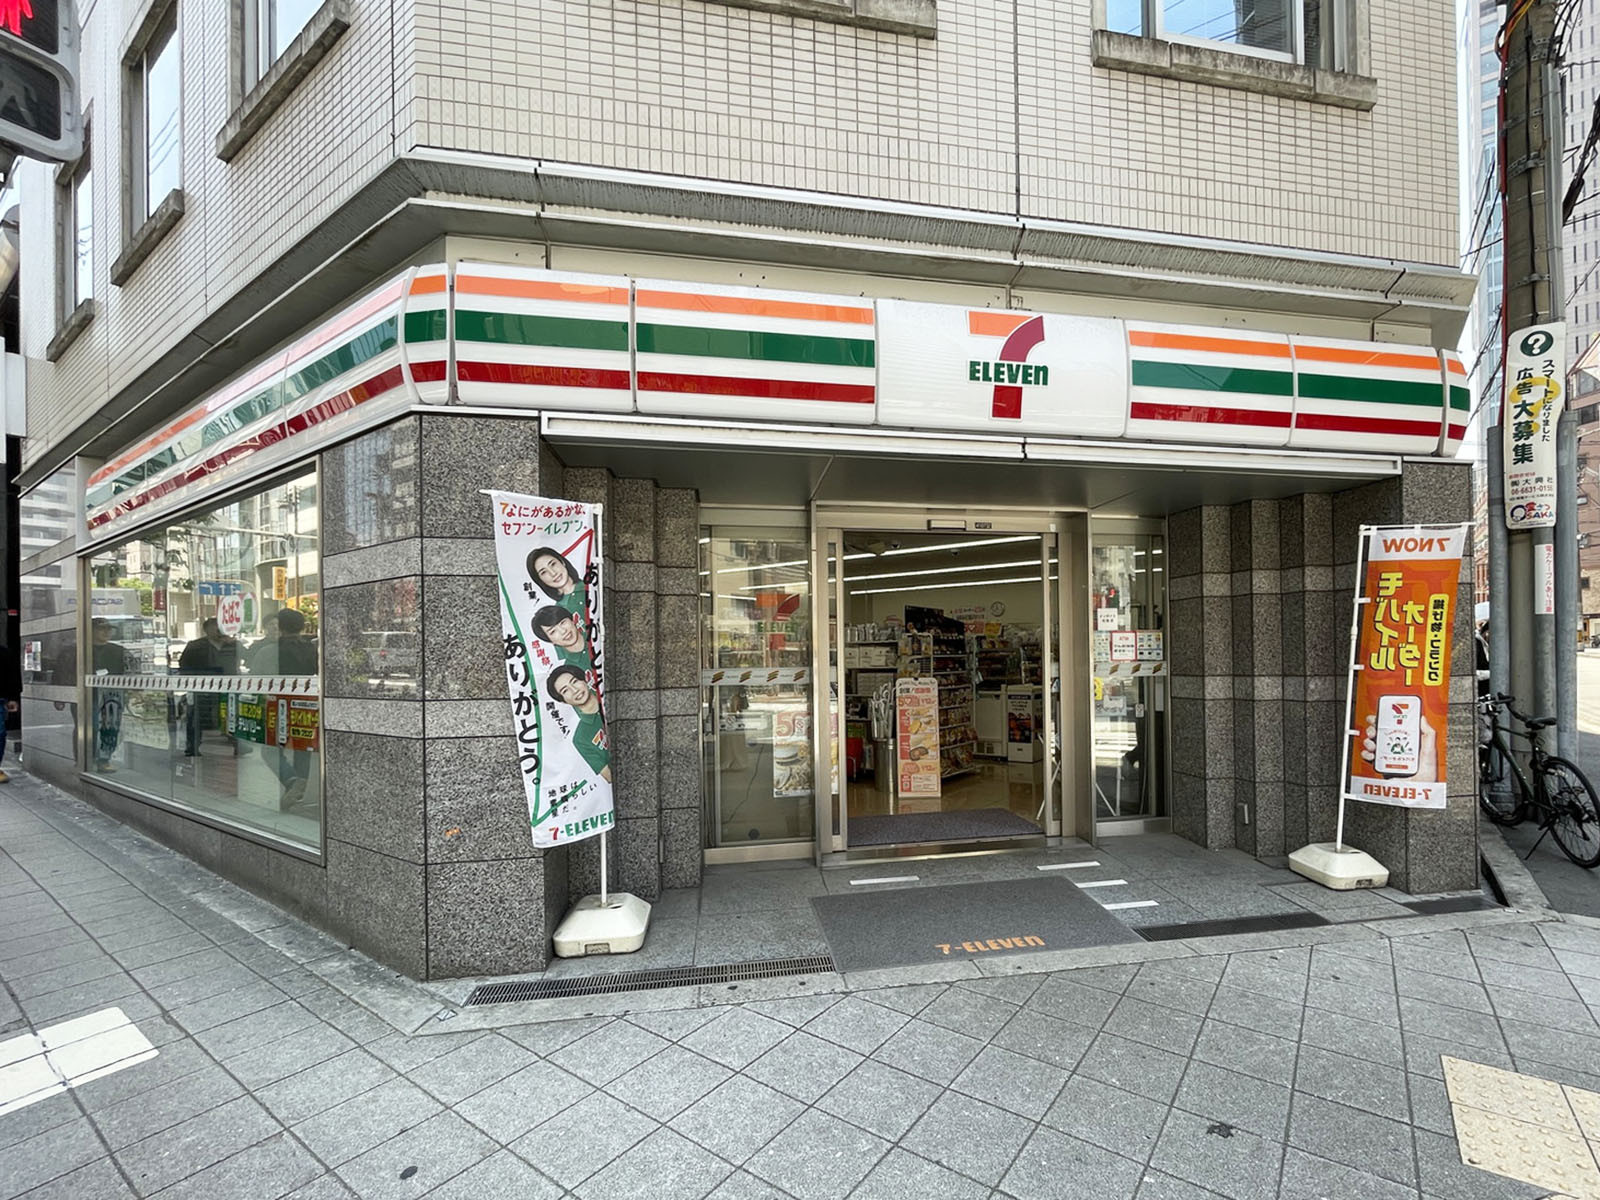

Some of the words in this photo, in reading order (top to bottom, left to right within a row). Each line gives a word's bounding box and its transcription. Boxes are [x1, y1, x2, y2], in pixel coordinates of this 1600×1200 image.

[1512, 367, 1535, 465] 広告大募集
[1541, 359, 1556, 442] スマートになりました
[221, 600, 241, 624] たばこ
[503, 634, 541, 785] ありがとう。
